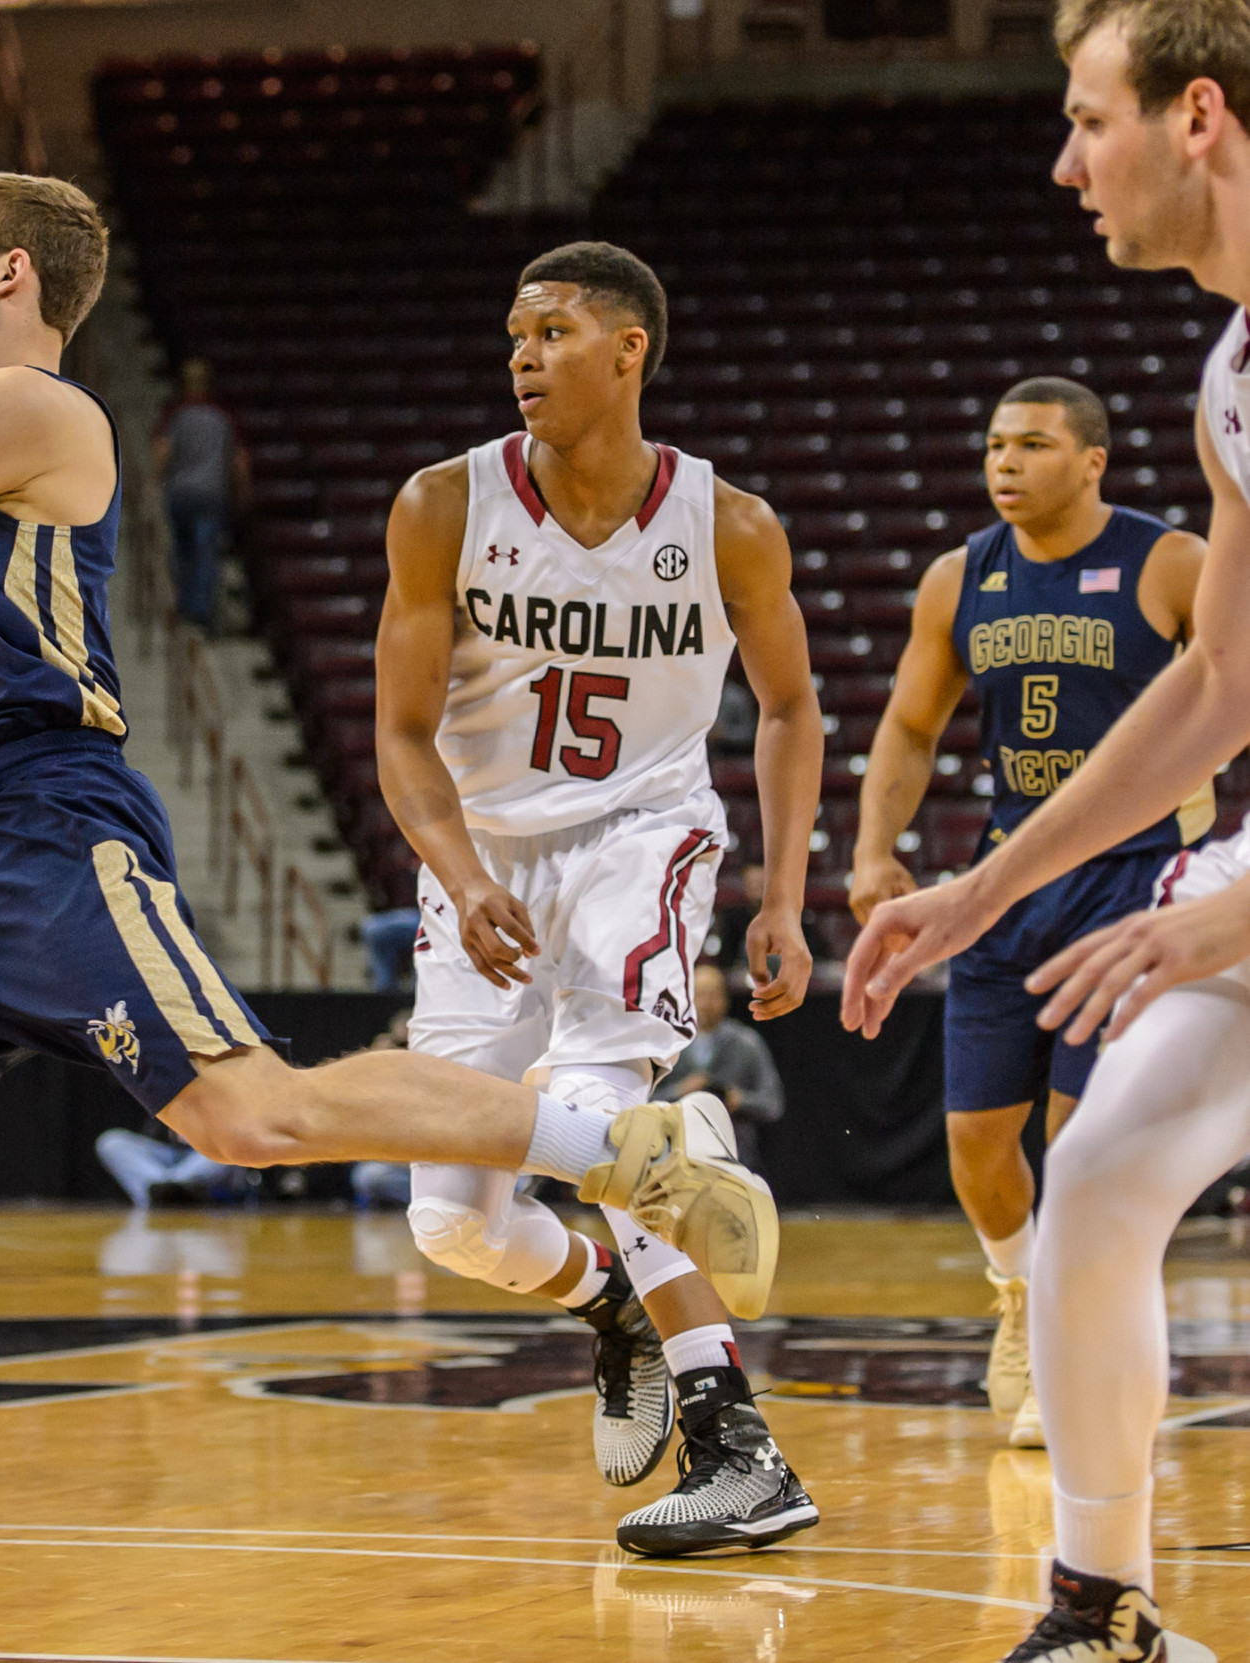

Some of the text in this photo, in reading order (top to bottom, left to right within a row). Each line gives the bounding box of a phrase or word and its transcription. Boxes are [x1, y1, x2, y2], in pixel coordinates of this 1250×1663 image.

[656, 546, 686, 579] SEC
[465, 588, 704, 659] CAROLINA
[969, 613, 1115, 675] GEORGIA
[529, 665, 630, 781] 15
[1021, 674, 1059, 740] 5
